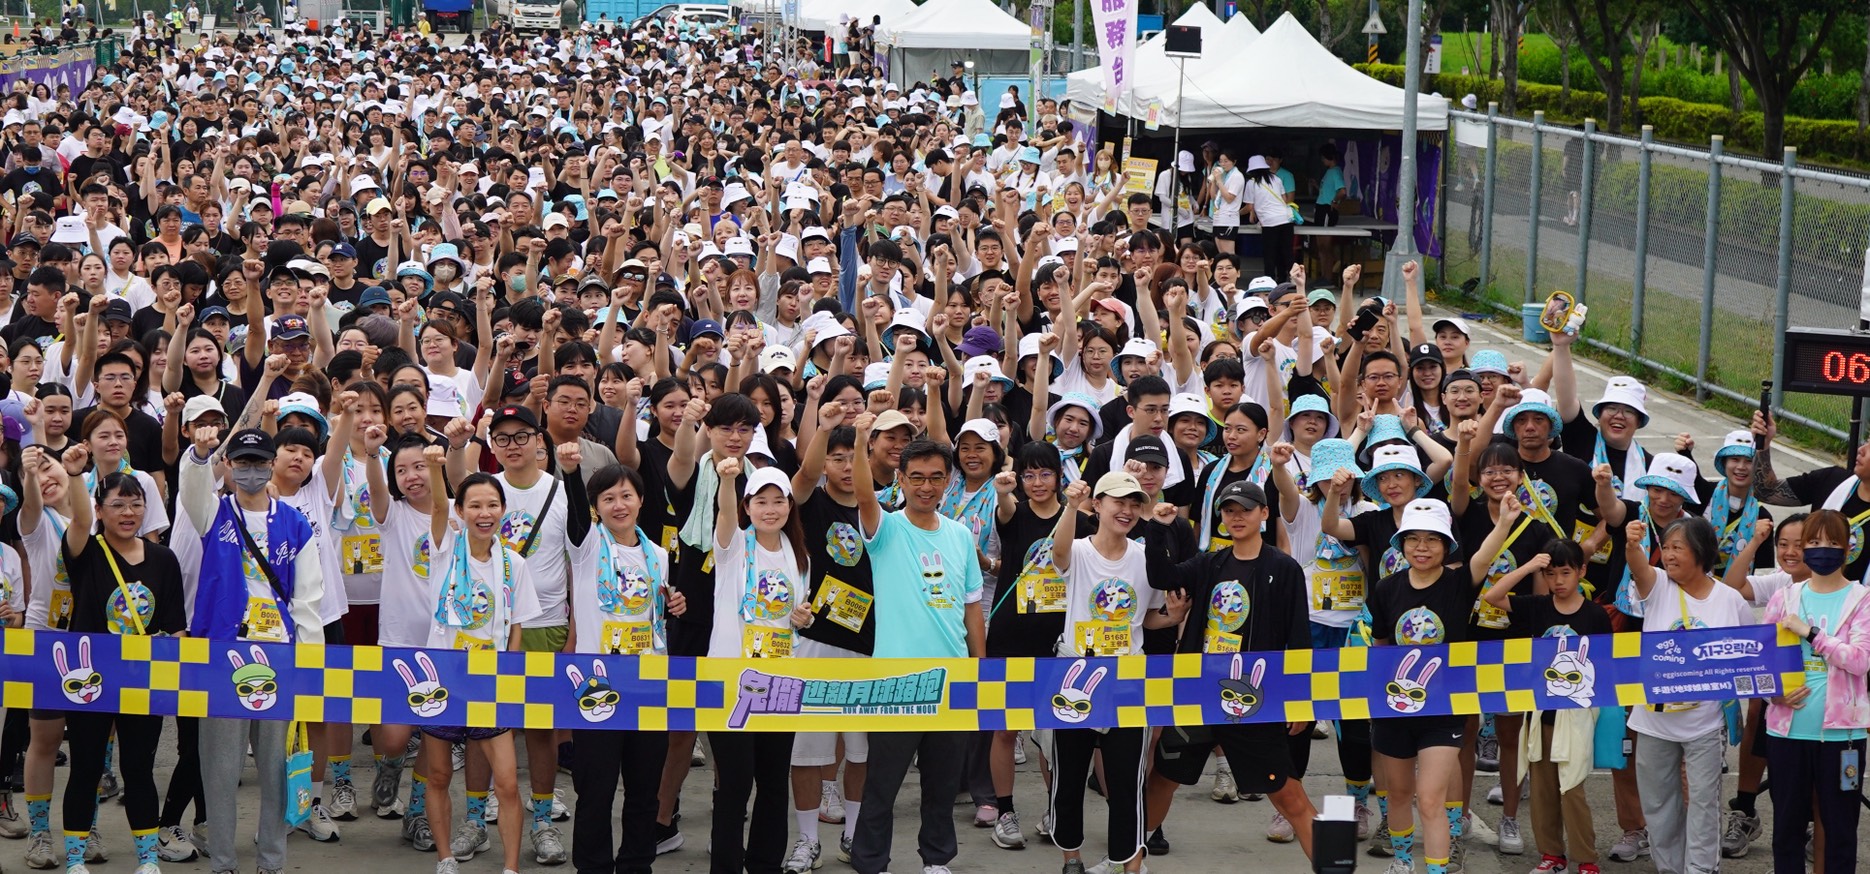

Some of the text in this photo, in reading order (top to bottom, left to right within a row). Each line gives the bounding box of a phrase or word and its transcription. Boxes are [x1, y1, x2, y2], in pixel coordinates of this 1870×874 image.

[1656, 638, 1675, 650] egg
[1652, 654, 1686, 665] coming
[1714, 667, 1735, 676] Rights
[842, 704, 937, 714] RUN AWAY FROM THE MOON
